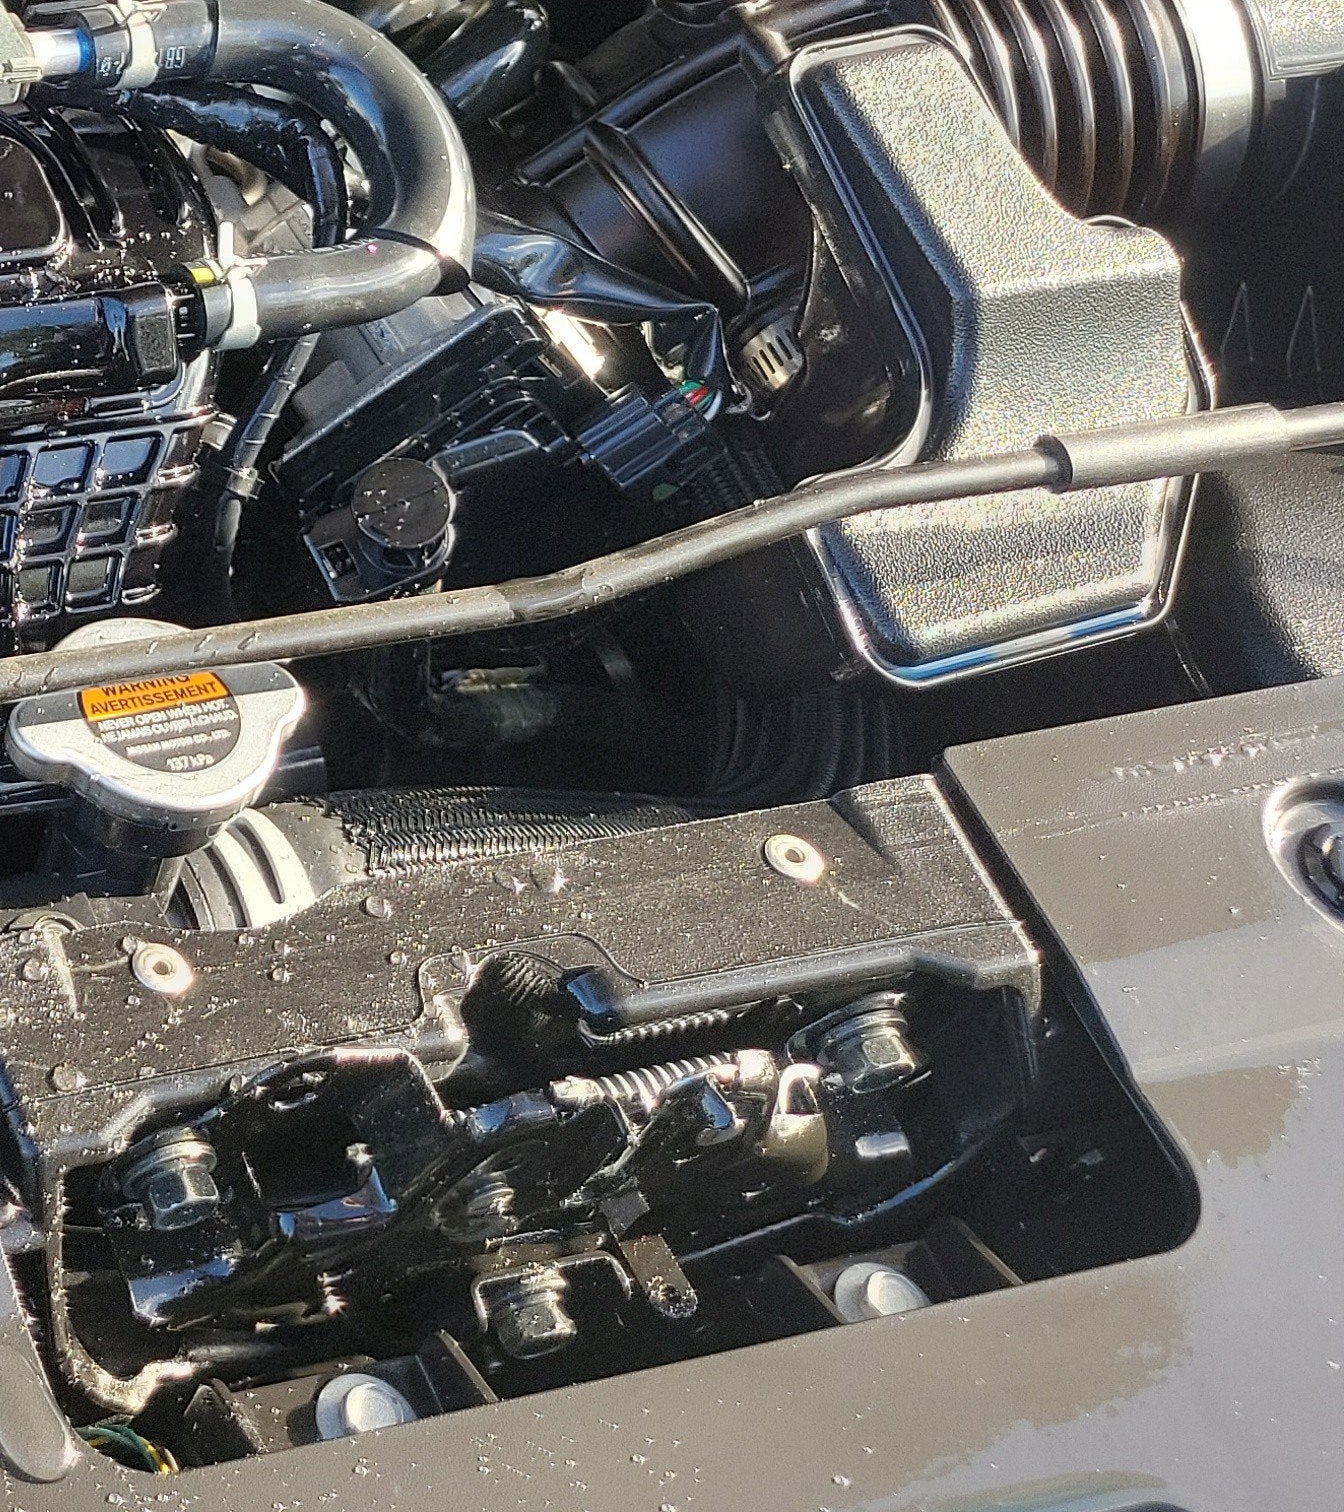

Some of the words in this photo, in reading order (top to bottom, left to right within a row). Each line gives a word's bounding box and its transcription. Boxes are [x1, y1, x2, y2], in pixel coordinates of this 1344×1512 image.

[91, 682, 218, 714] AVERTISSEMENT
[98, 716, 137, 731] NEVER
[138, 710, 166, 726] OPEN
[168, 703, 202, 721] WHEN
[165, 754, 189, 772] 137
